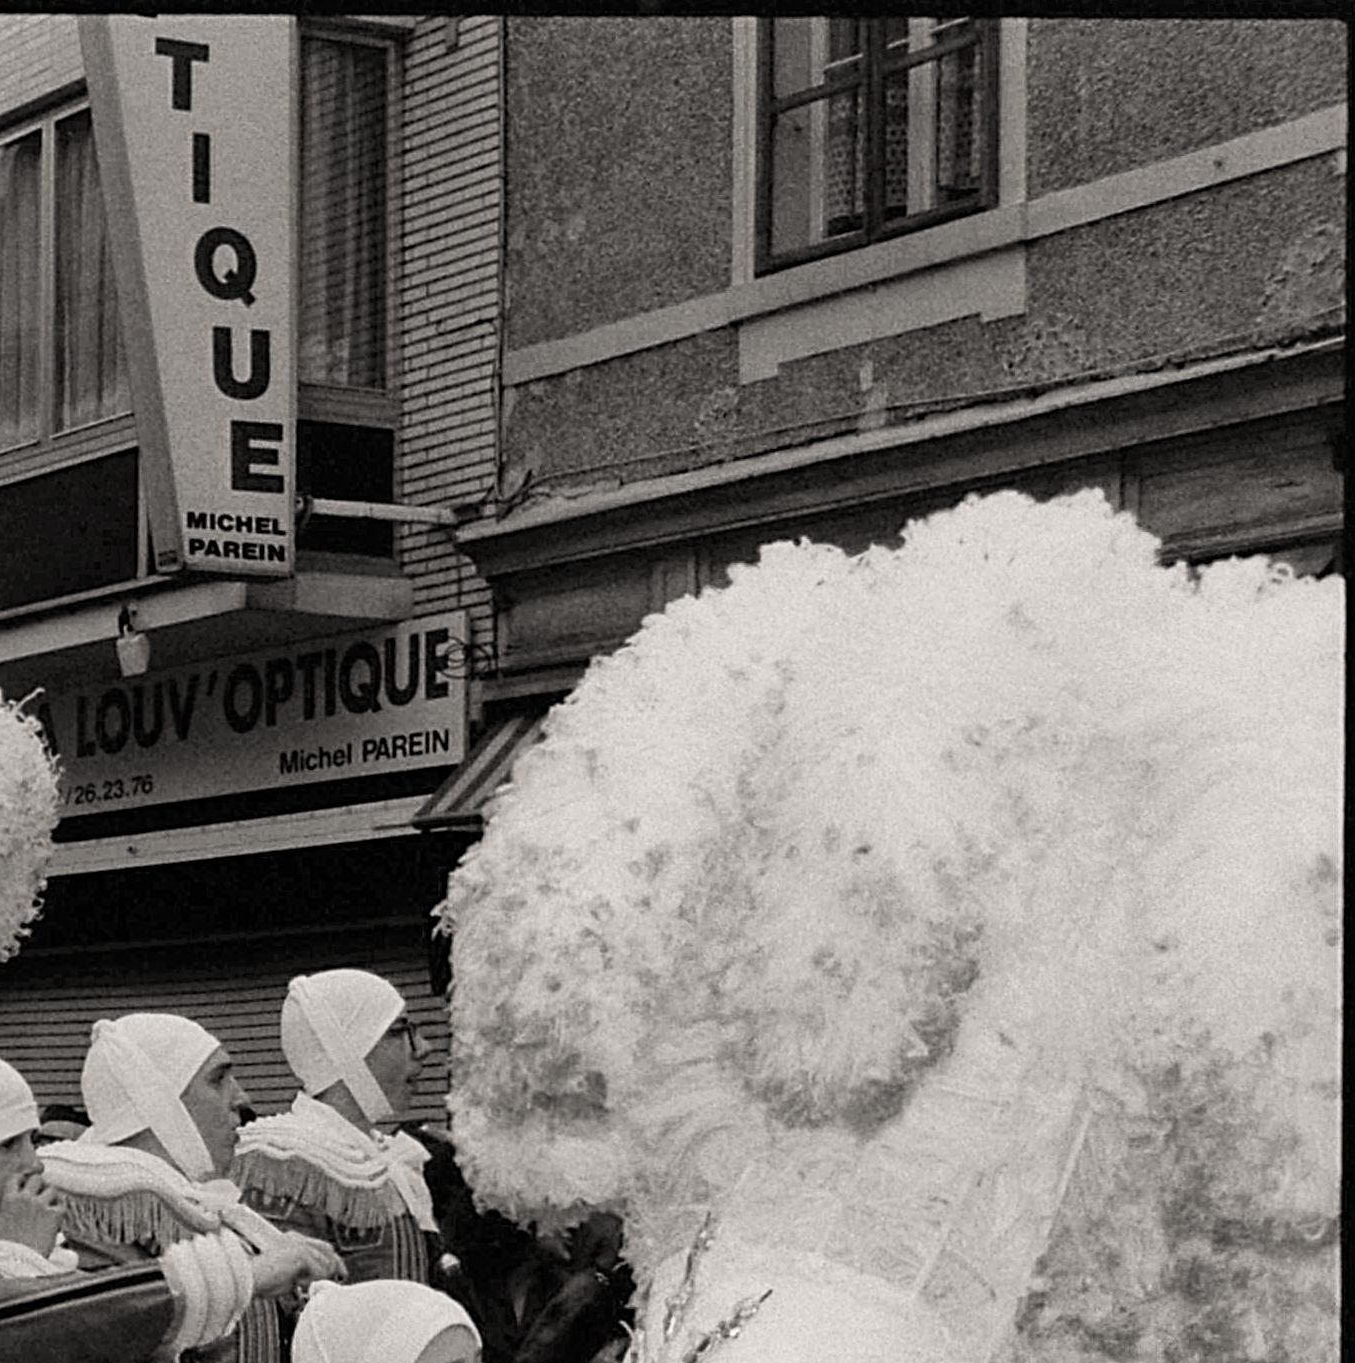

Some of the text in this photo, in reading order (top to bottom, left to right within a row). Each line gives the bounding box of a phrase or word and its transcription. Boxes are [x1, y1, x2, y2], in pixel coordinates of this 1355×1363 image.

[139, 14, 285, 494] TIQUE
[186, 511, 287, 536] MICHEL
[189, 538, 286, 563] PAREIN
[279, 729, 450, 776] Michel PAREIN
[58, 773, 154, 806] /26.23.76
